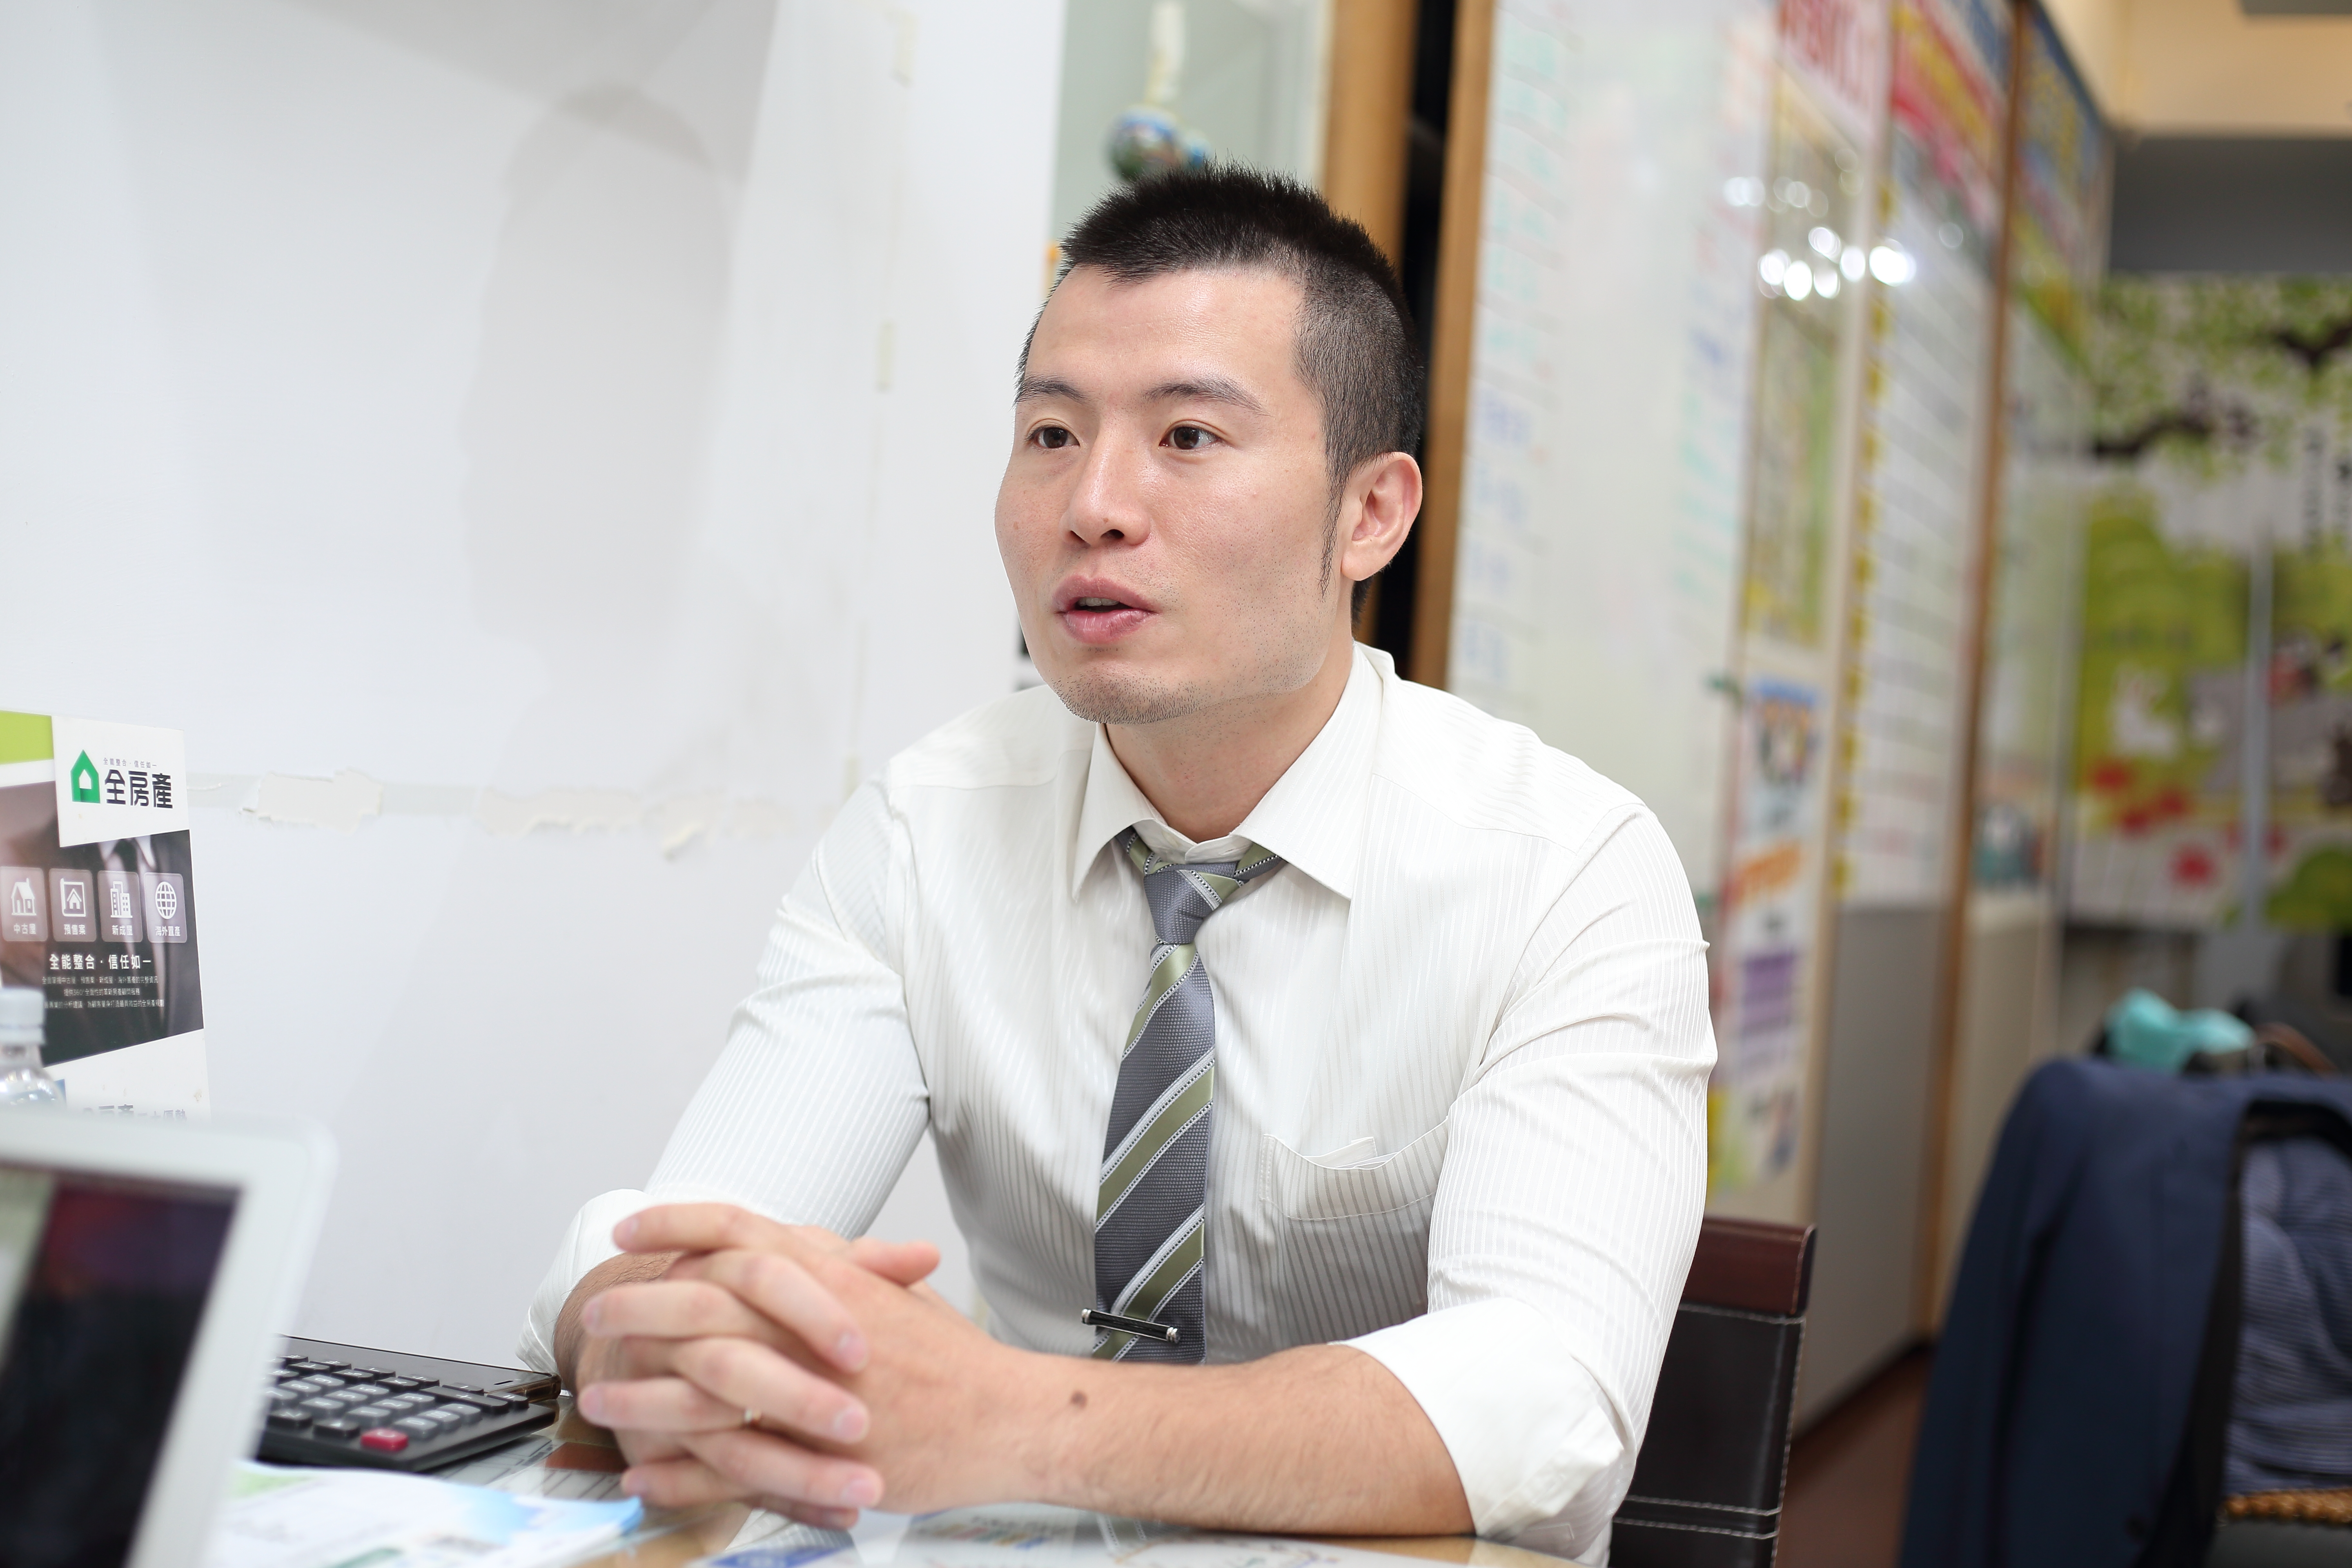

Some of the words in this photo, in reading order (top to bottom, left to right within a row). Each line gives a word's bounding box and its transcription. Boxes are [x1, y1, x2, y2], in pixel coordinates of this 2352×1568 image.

[105, 769, 173, 808] 全房產
[13, 923, 37, 934] 中古屋
[64, 924, 86, 935] 預售案
[112, 925, 133, 936] 新成屋
[155, 926, 180, 936] 海外置產
